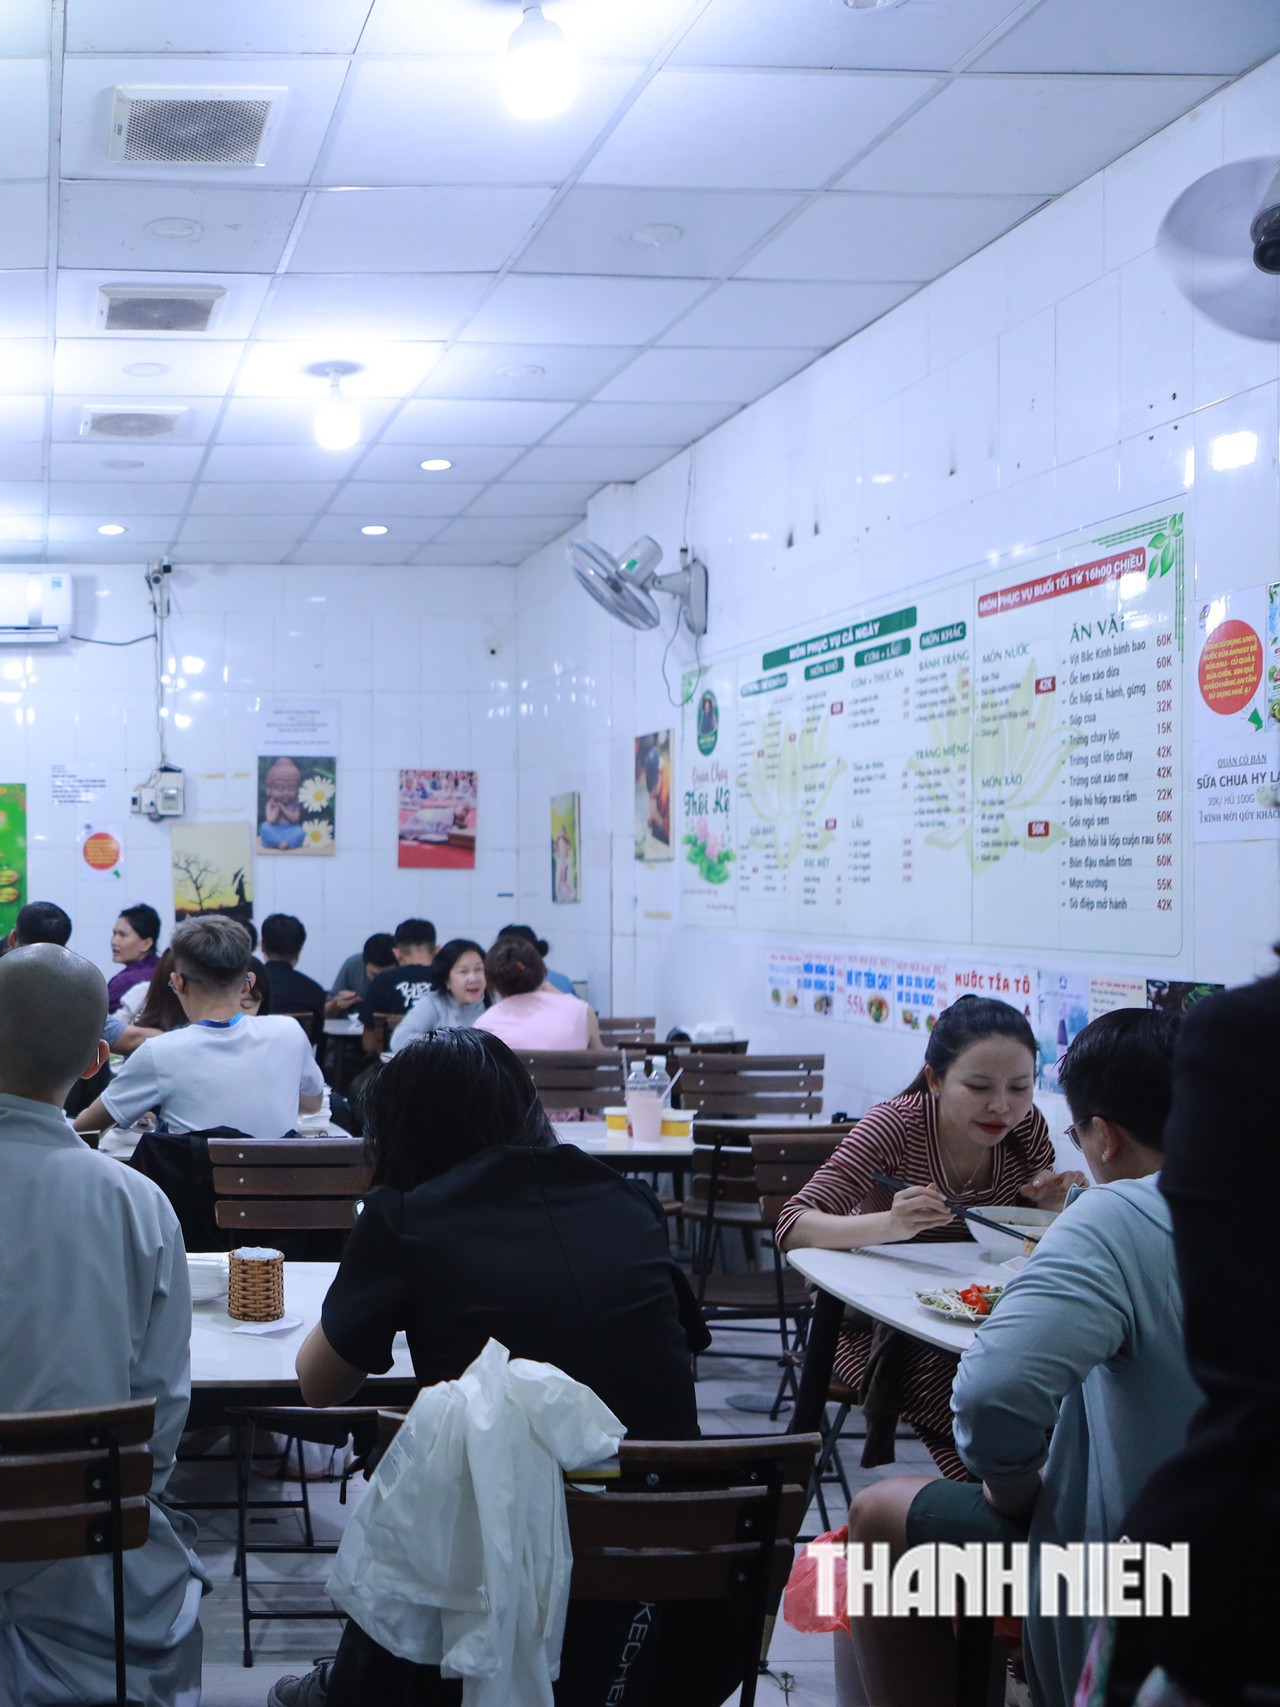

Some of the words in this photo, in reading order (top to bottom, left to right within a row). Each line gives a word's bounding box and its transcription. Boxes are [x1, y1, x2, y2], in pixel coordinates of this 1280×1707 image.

[1070, 617, 1092, 643] ĂN
[1095, 646, 1111, 660] Kinh
[1113, 640, 1130, 656] bánh
[1132, 639, 1146, 652] bao
[1156, 633, 1172, 647] 60K
[1084, 713, 1096, 724] cua
[1156, 699, 1172, 713] 32K
[1090, 730, 1108, 745] chay
[1156, 721, 1172, 735] 15K
[1116, 747, 1133, 763] chay
[1156, 745, 1172, 759] 42K
[1218, 754, 1237, 768] QUÁN
[1251, 751, 1267, 764] BÁN
[1118, 772, 1129, 782] me
[1156, 766, 1172, 779] 42K
[1197, 774, 1217, 790] SỮA
[1219, 773, 1248, 787] CHUA
[1251, 771, 1267, 784] HY
[1097, 815, 1109, 826] sen
[1156, 810, 1172, 823] 60K
[1156, 878, 1172, 891] 55K
[1014, 974, 1030, 995] TÔ
[605, 1601, 655, 1707] KECHE
